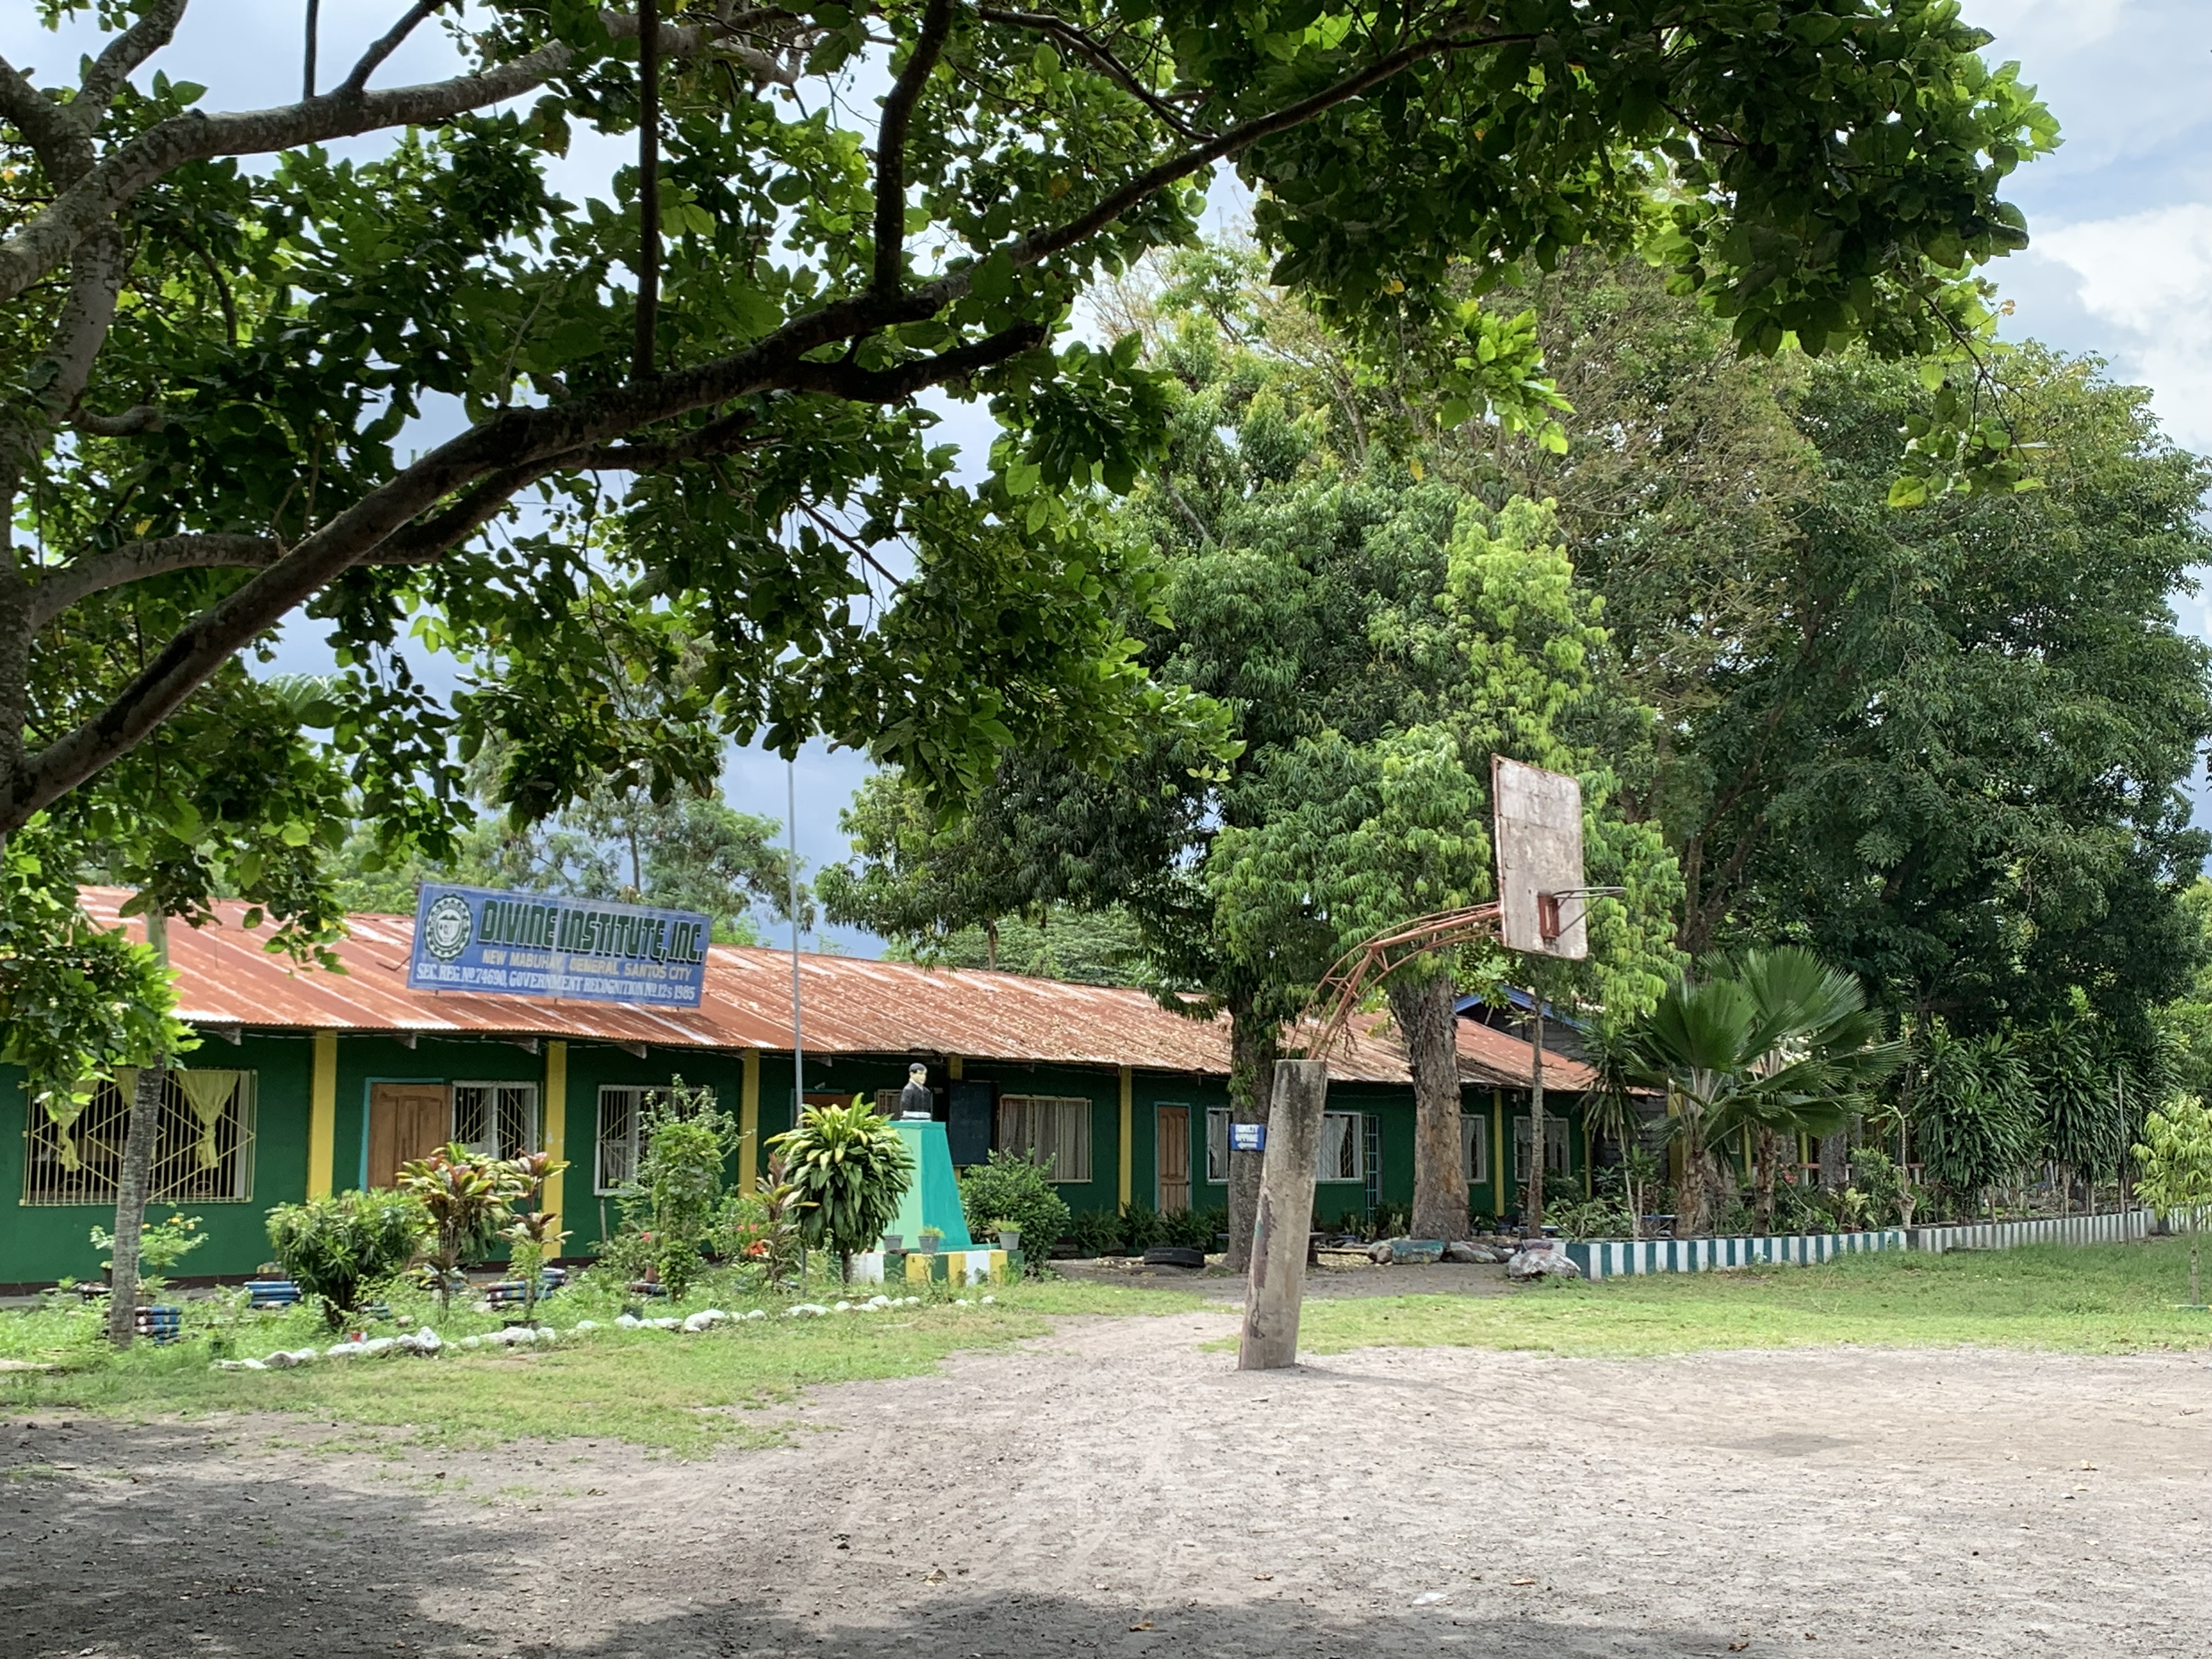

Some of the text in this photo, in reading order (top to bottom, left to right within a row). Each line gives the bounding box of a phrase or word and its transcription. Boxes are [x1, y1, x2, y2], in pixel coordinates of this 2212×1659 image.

[478, 900, 558, 948] DIVINE
[668, 921, 703, 965] INC.
[416, 962, 439, 980] SEC.
[509, 971, 583, 991] GOVERNMENT
[583, 977, 645, 997] RECOGNITION
[673, 985, 696, 1001] 1985
[483, 949, 506, 965] NEW
[569, 958, 619, 975] GENERAL
[624, 963, 667, 979] SANTOS
[669, 967, 692, 981] CITY
